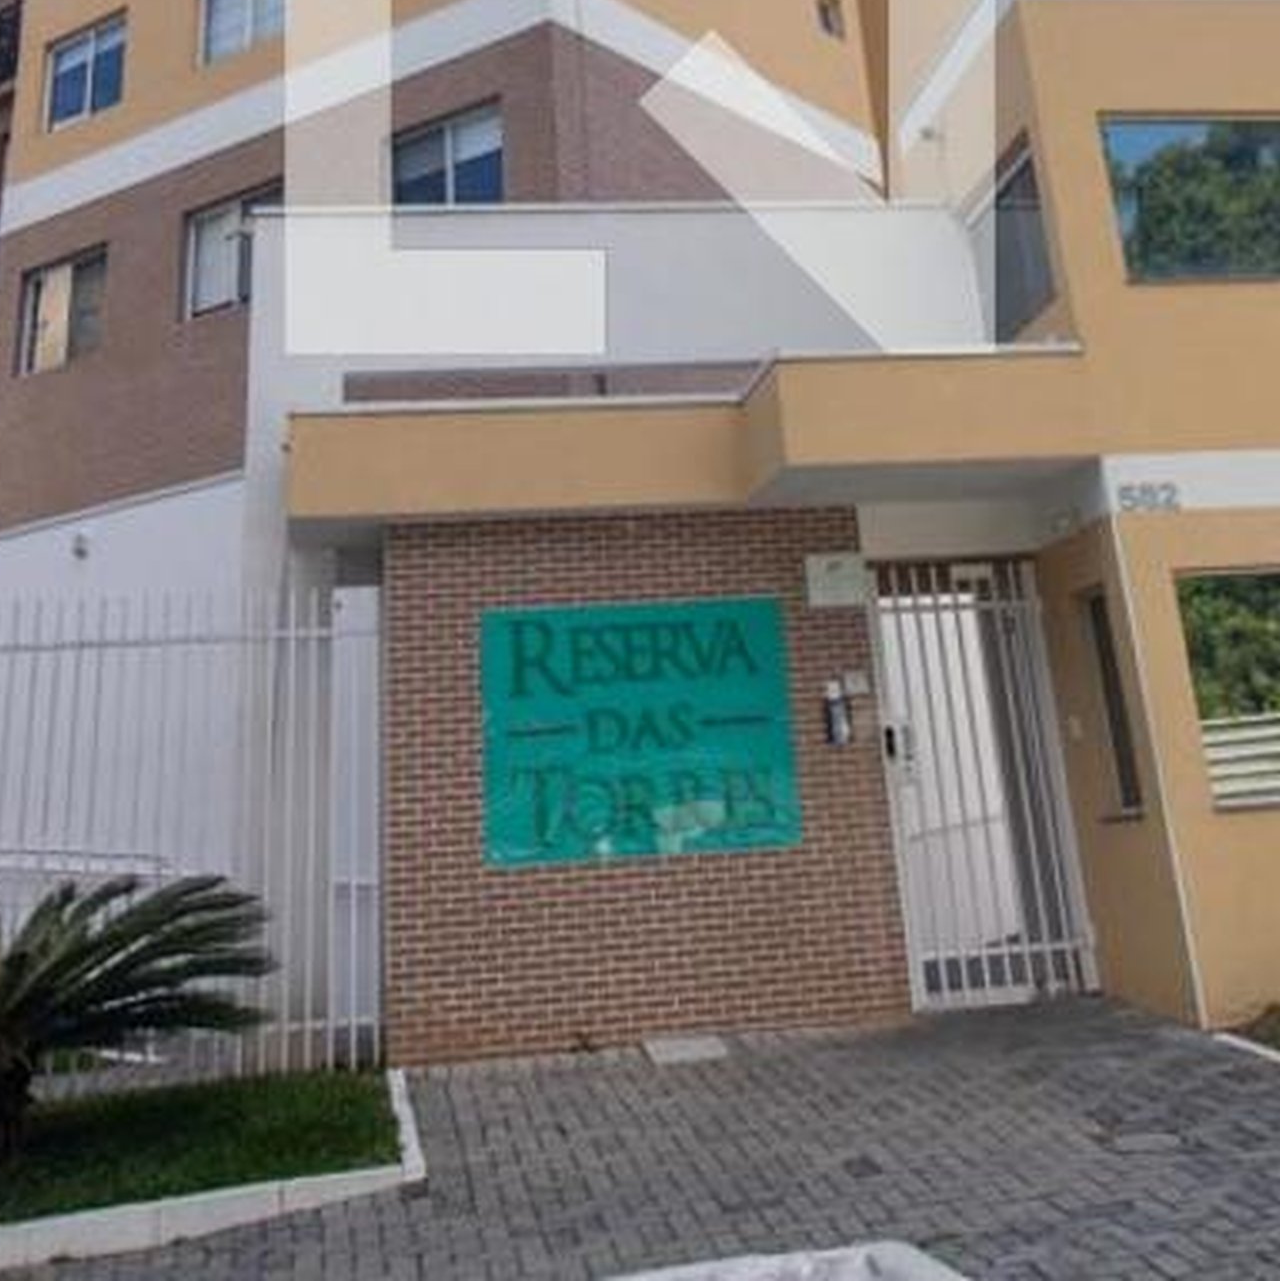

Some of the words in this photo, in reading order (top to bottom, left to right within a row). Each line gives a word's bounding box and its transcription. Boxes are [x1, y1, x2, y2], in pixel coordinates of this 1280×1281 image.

[1118, 483, 1180, 515] 582
[507, 619, 759, 700] RESERVA
[583, 701, 696, 754] DAS
